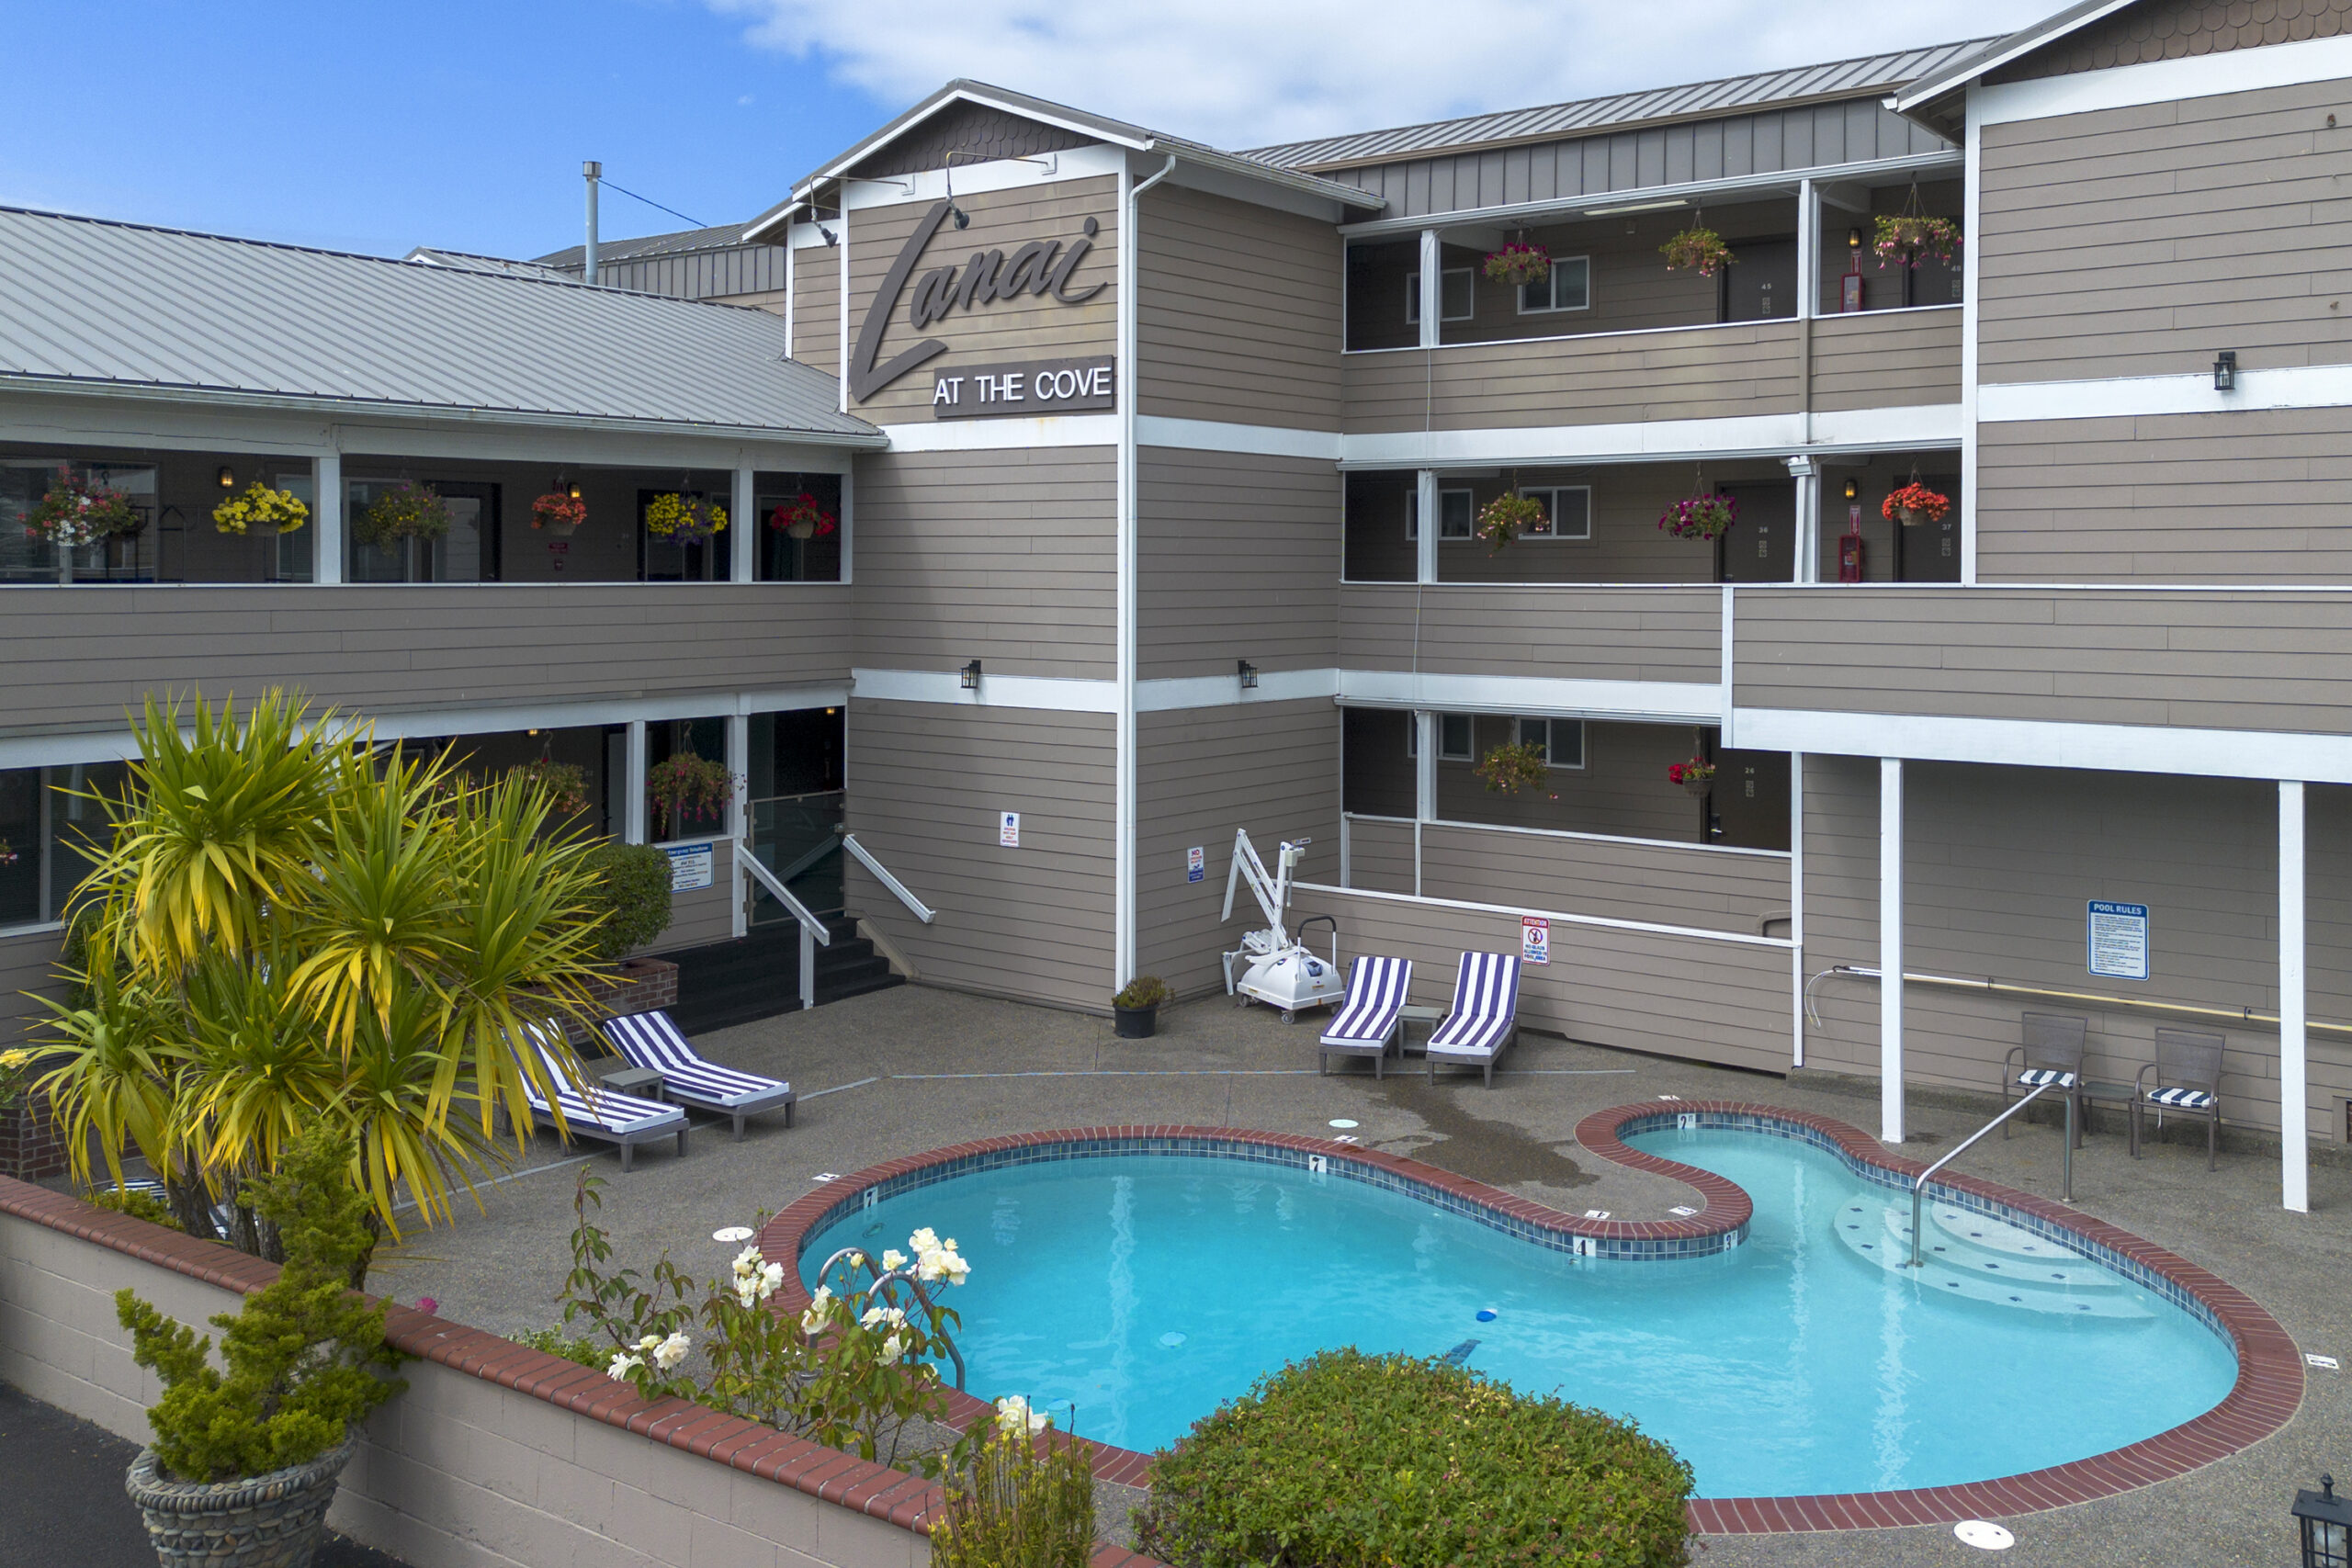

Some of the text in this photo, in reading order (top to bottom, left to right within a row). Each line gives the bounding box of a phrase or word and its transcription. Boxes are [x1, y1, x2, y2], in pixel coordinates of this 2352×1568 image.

[849, 201, 1108, 403] Lanai
[933, 367, 1112, 404] AT THE COVE
[2094, 903, 2142, 915] POOL RULES
[1576, 1239, 1588, 1256] 4
[1726, 1235, 1732, 1250] 3
